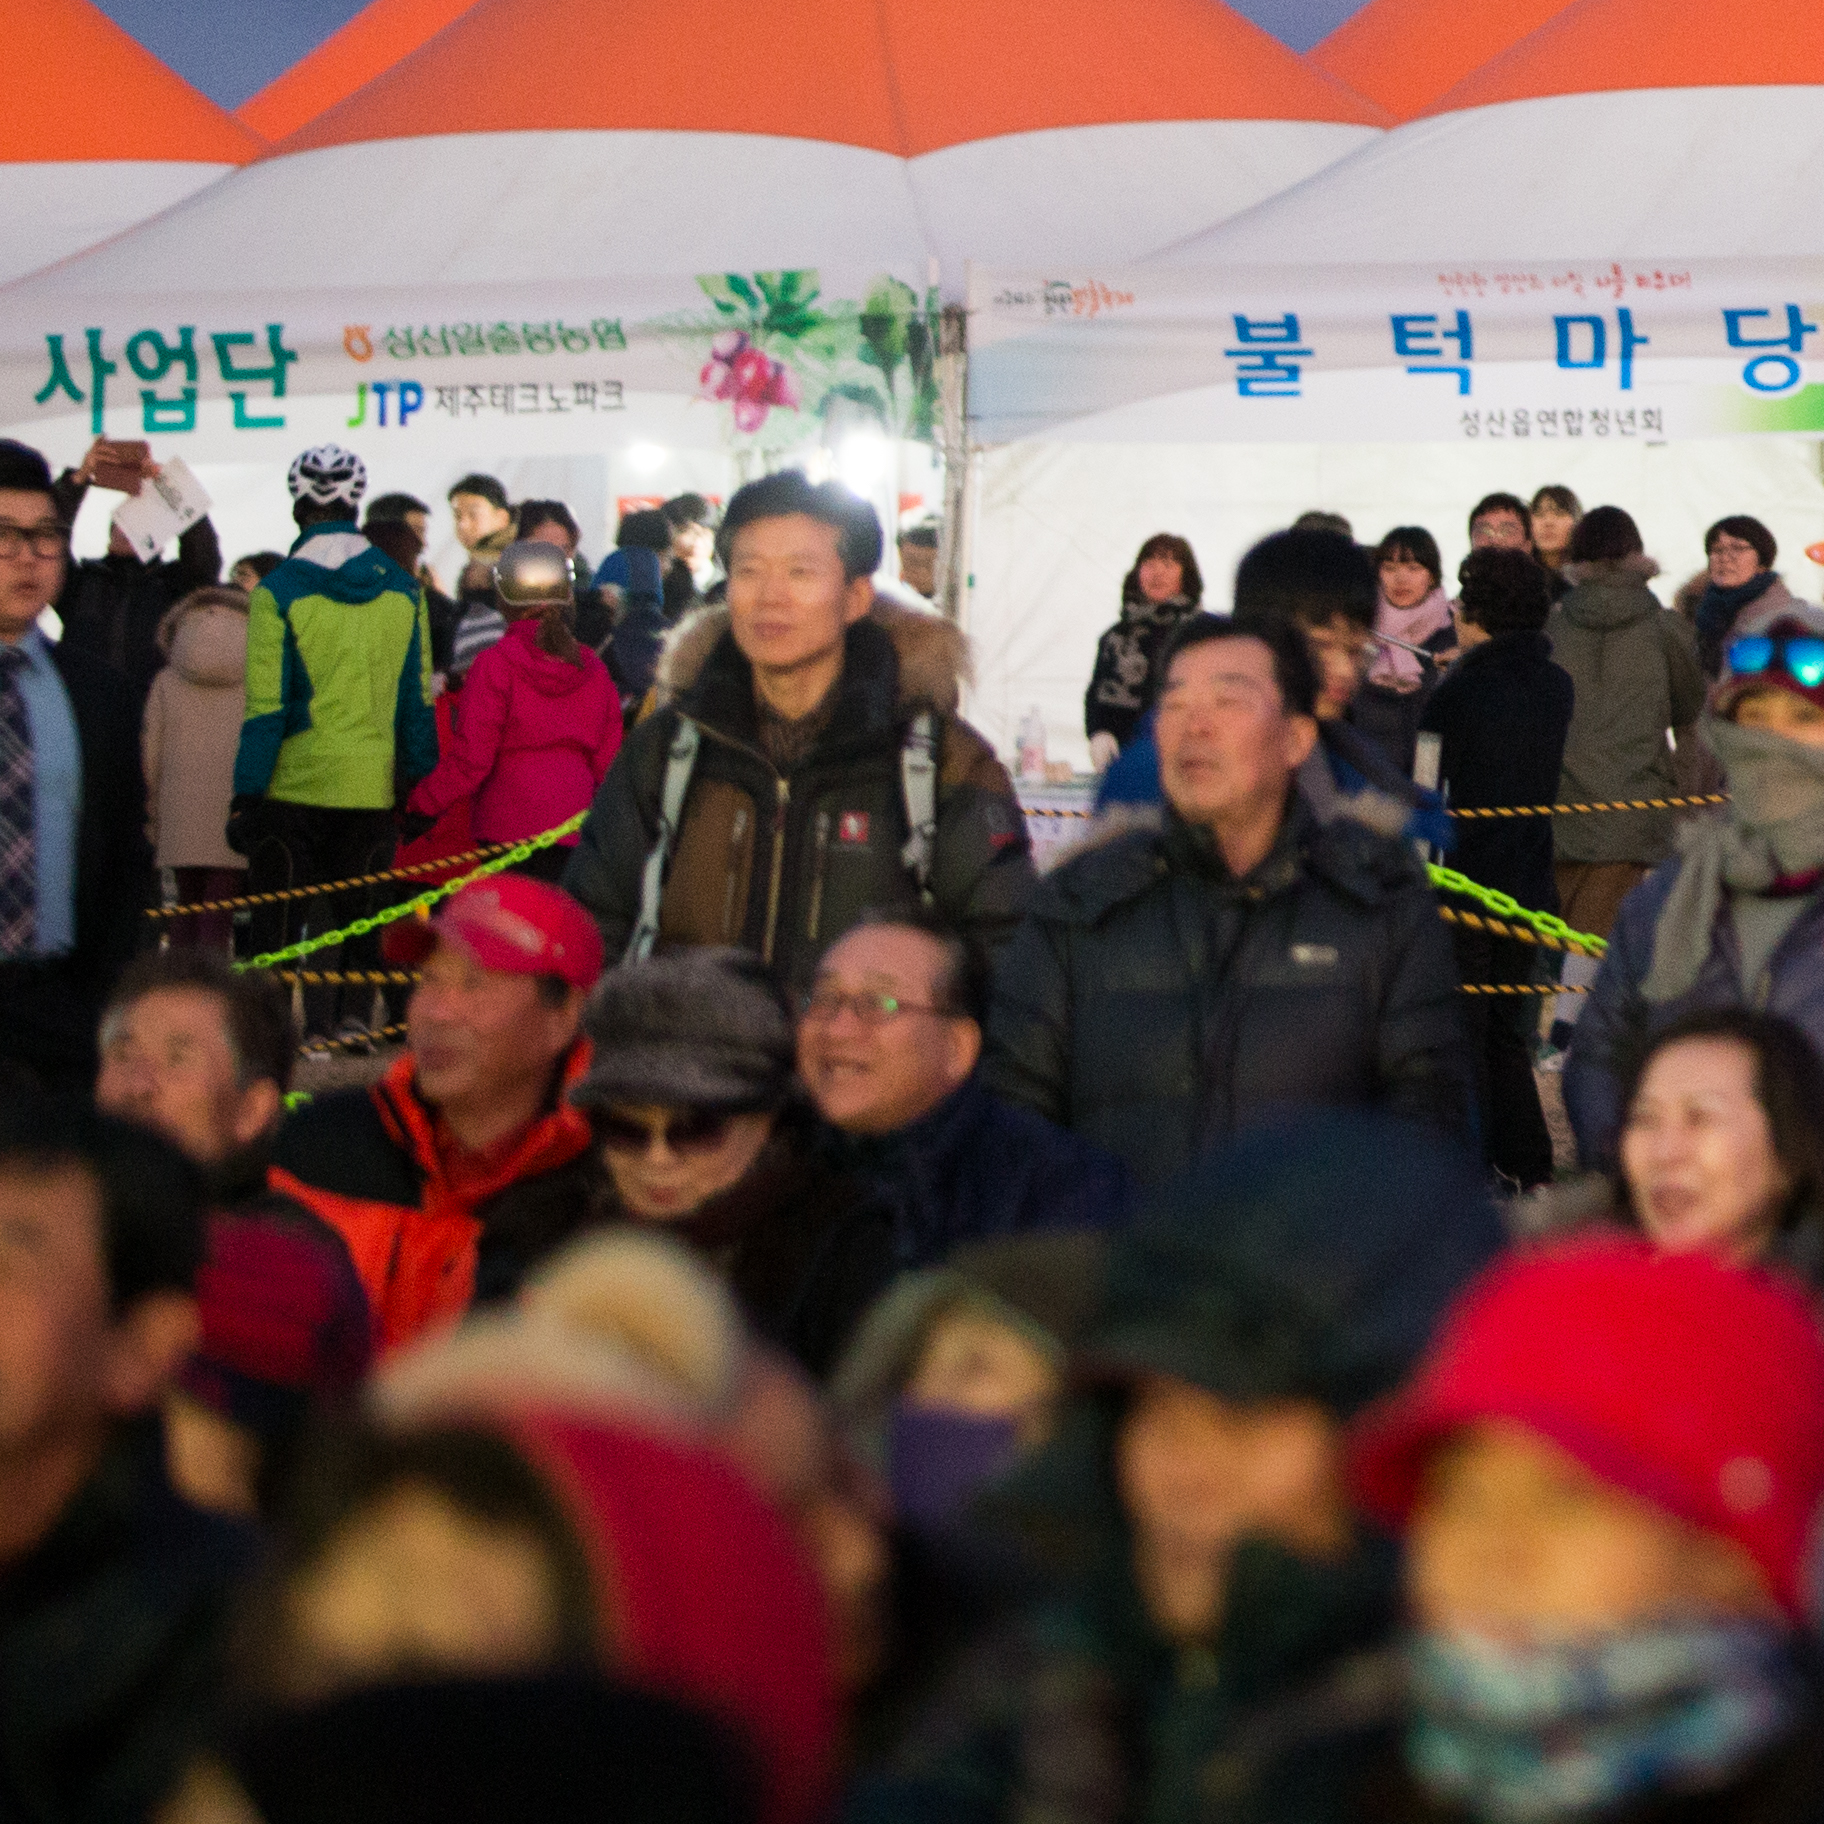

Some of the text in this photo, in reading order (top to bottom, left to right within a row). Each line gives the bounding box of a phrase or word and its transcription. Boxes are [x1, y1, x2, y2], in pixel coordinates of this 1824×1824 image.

[34, 323, 298, 435] 사업단
[347, 379, 627, 428] JTP 제주테크노파크
[1460, 407, 1668, 447] 성산읍연합청년회
